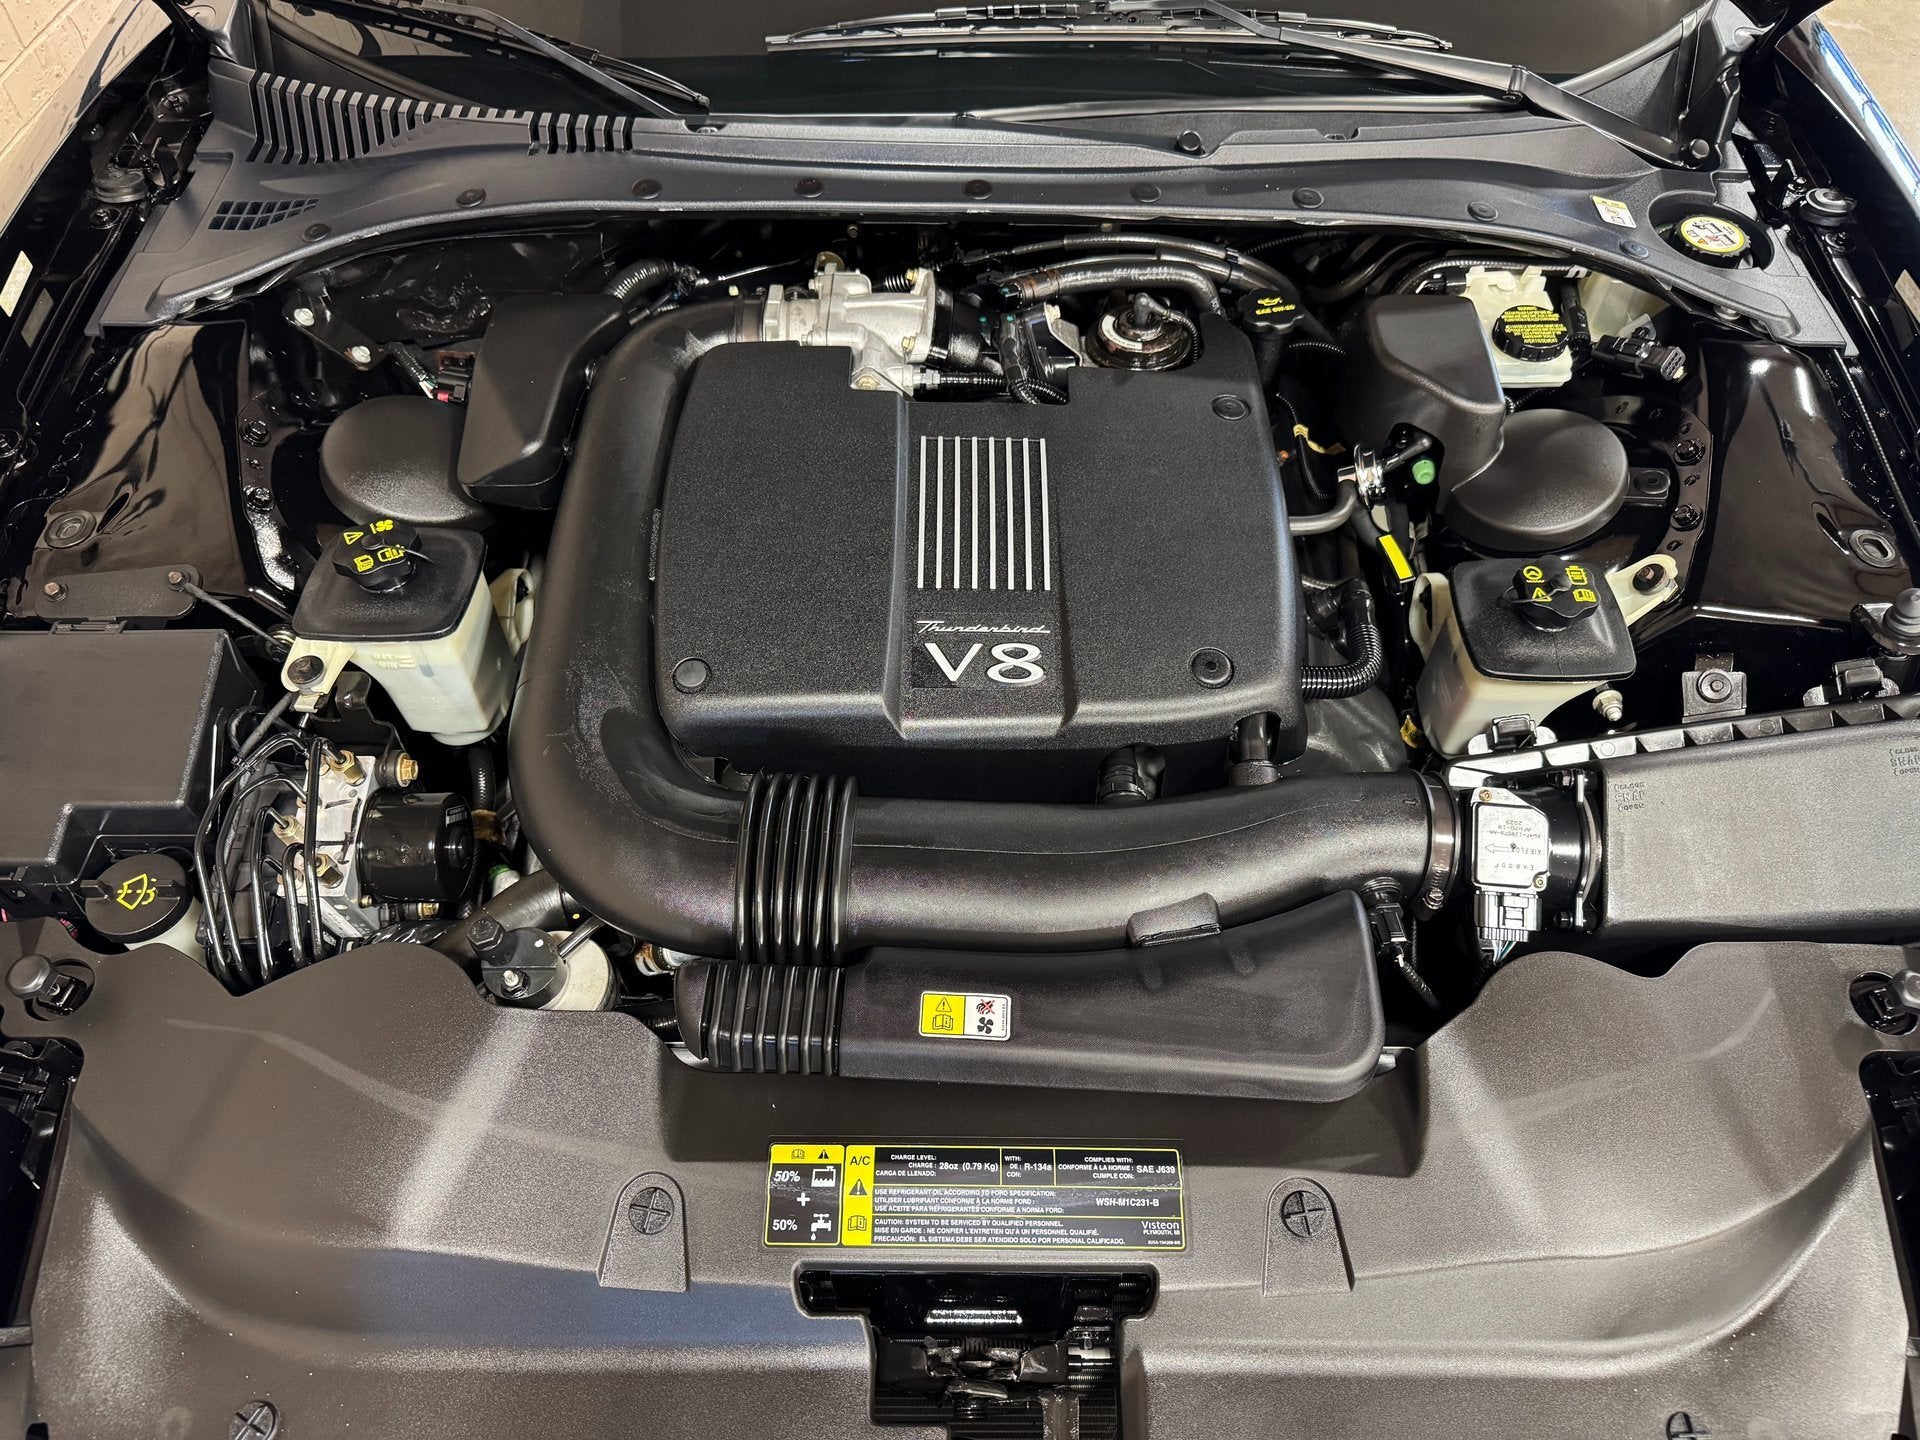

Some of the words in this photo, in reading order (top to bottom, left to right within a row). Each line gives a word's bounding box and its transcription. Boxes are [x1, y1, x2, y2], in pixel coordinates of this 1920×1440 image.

[916, 620, 1050, 634] Thunderbird
[924, 642, 1045, 684] V8
[850, 1156, 870, 1166] A/C
[962, 1162, 982, 1172] (0.79
[984, 1162, 998, 1172] Kg)
[774, 1171, 800, 1182] 50%
[1096, 1198, 1159, 1207] WSH-M1C231-B
[772, 1219, 798, 1230] 50%
[1142, 1221, 1179, 1230] Visteon
